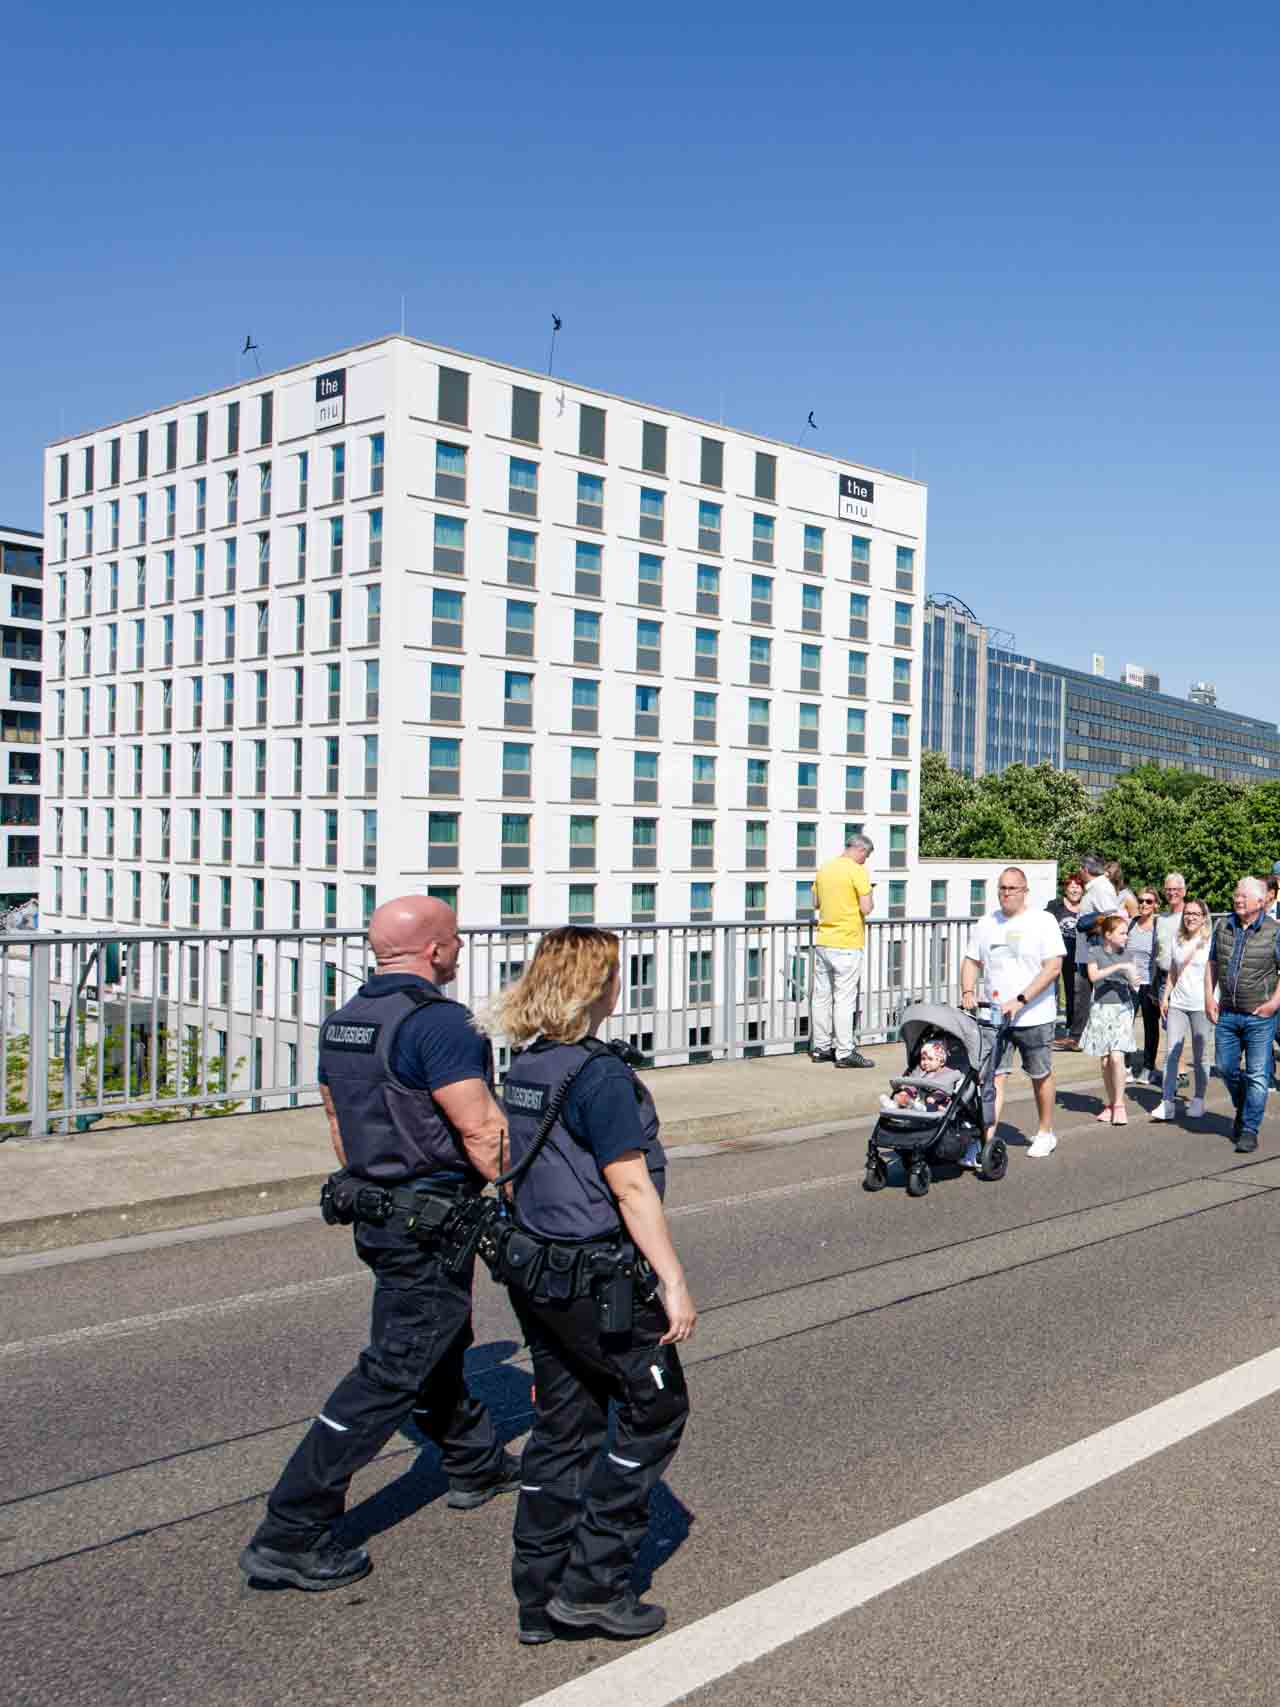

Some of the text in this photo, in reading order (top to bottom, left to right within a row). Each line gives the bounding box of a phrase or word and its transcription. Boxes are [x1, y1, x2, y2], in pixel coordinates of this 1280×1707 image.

[321, 378, 338, 396] the
[320, 403, 338, 420] niu
[847, 479, 868, 498] the
[846, 503, 868, 517] niu
